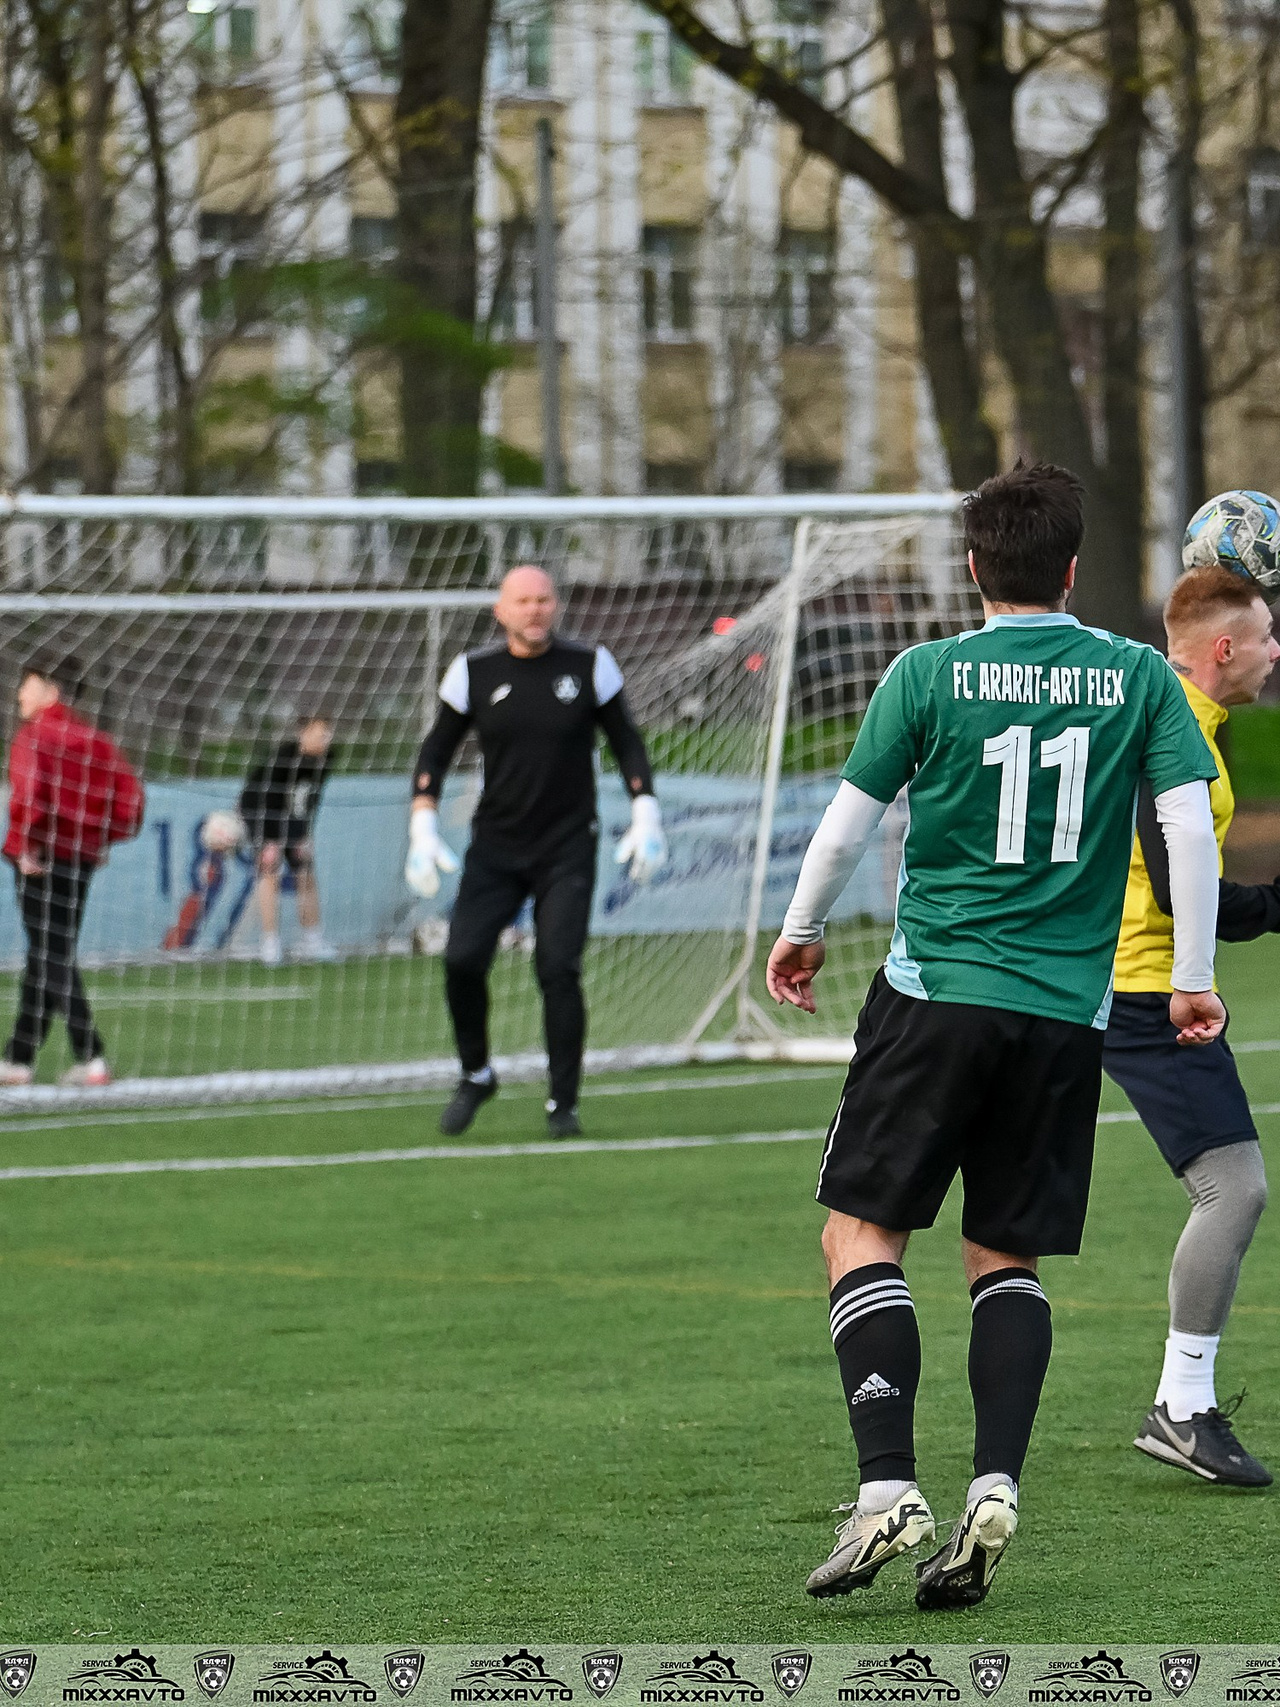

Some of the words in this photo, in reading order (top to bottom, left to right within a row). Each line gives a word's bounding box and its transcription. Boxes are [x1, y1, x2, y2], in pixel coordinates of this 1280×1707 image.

[953, 661, 973, 700] FC
[979, 662, 1082, 704] ARARAT-ART
[1087, 667, 1125, 706] FLEX
[982, 725, 1091, 864] 11
[851, 1388, 900, 1405] adidas
